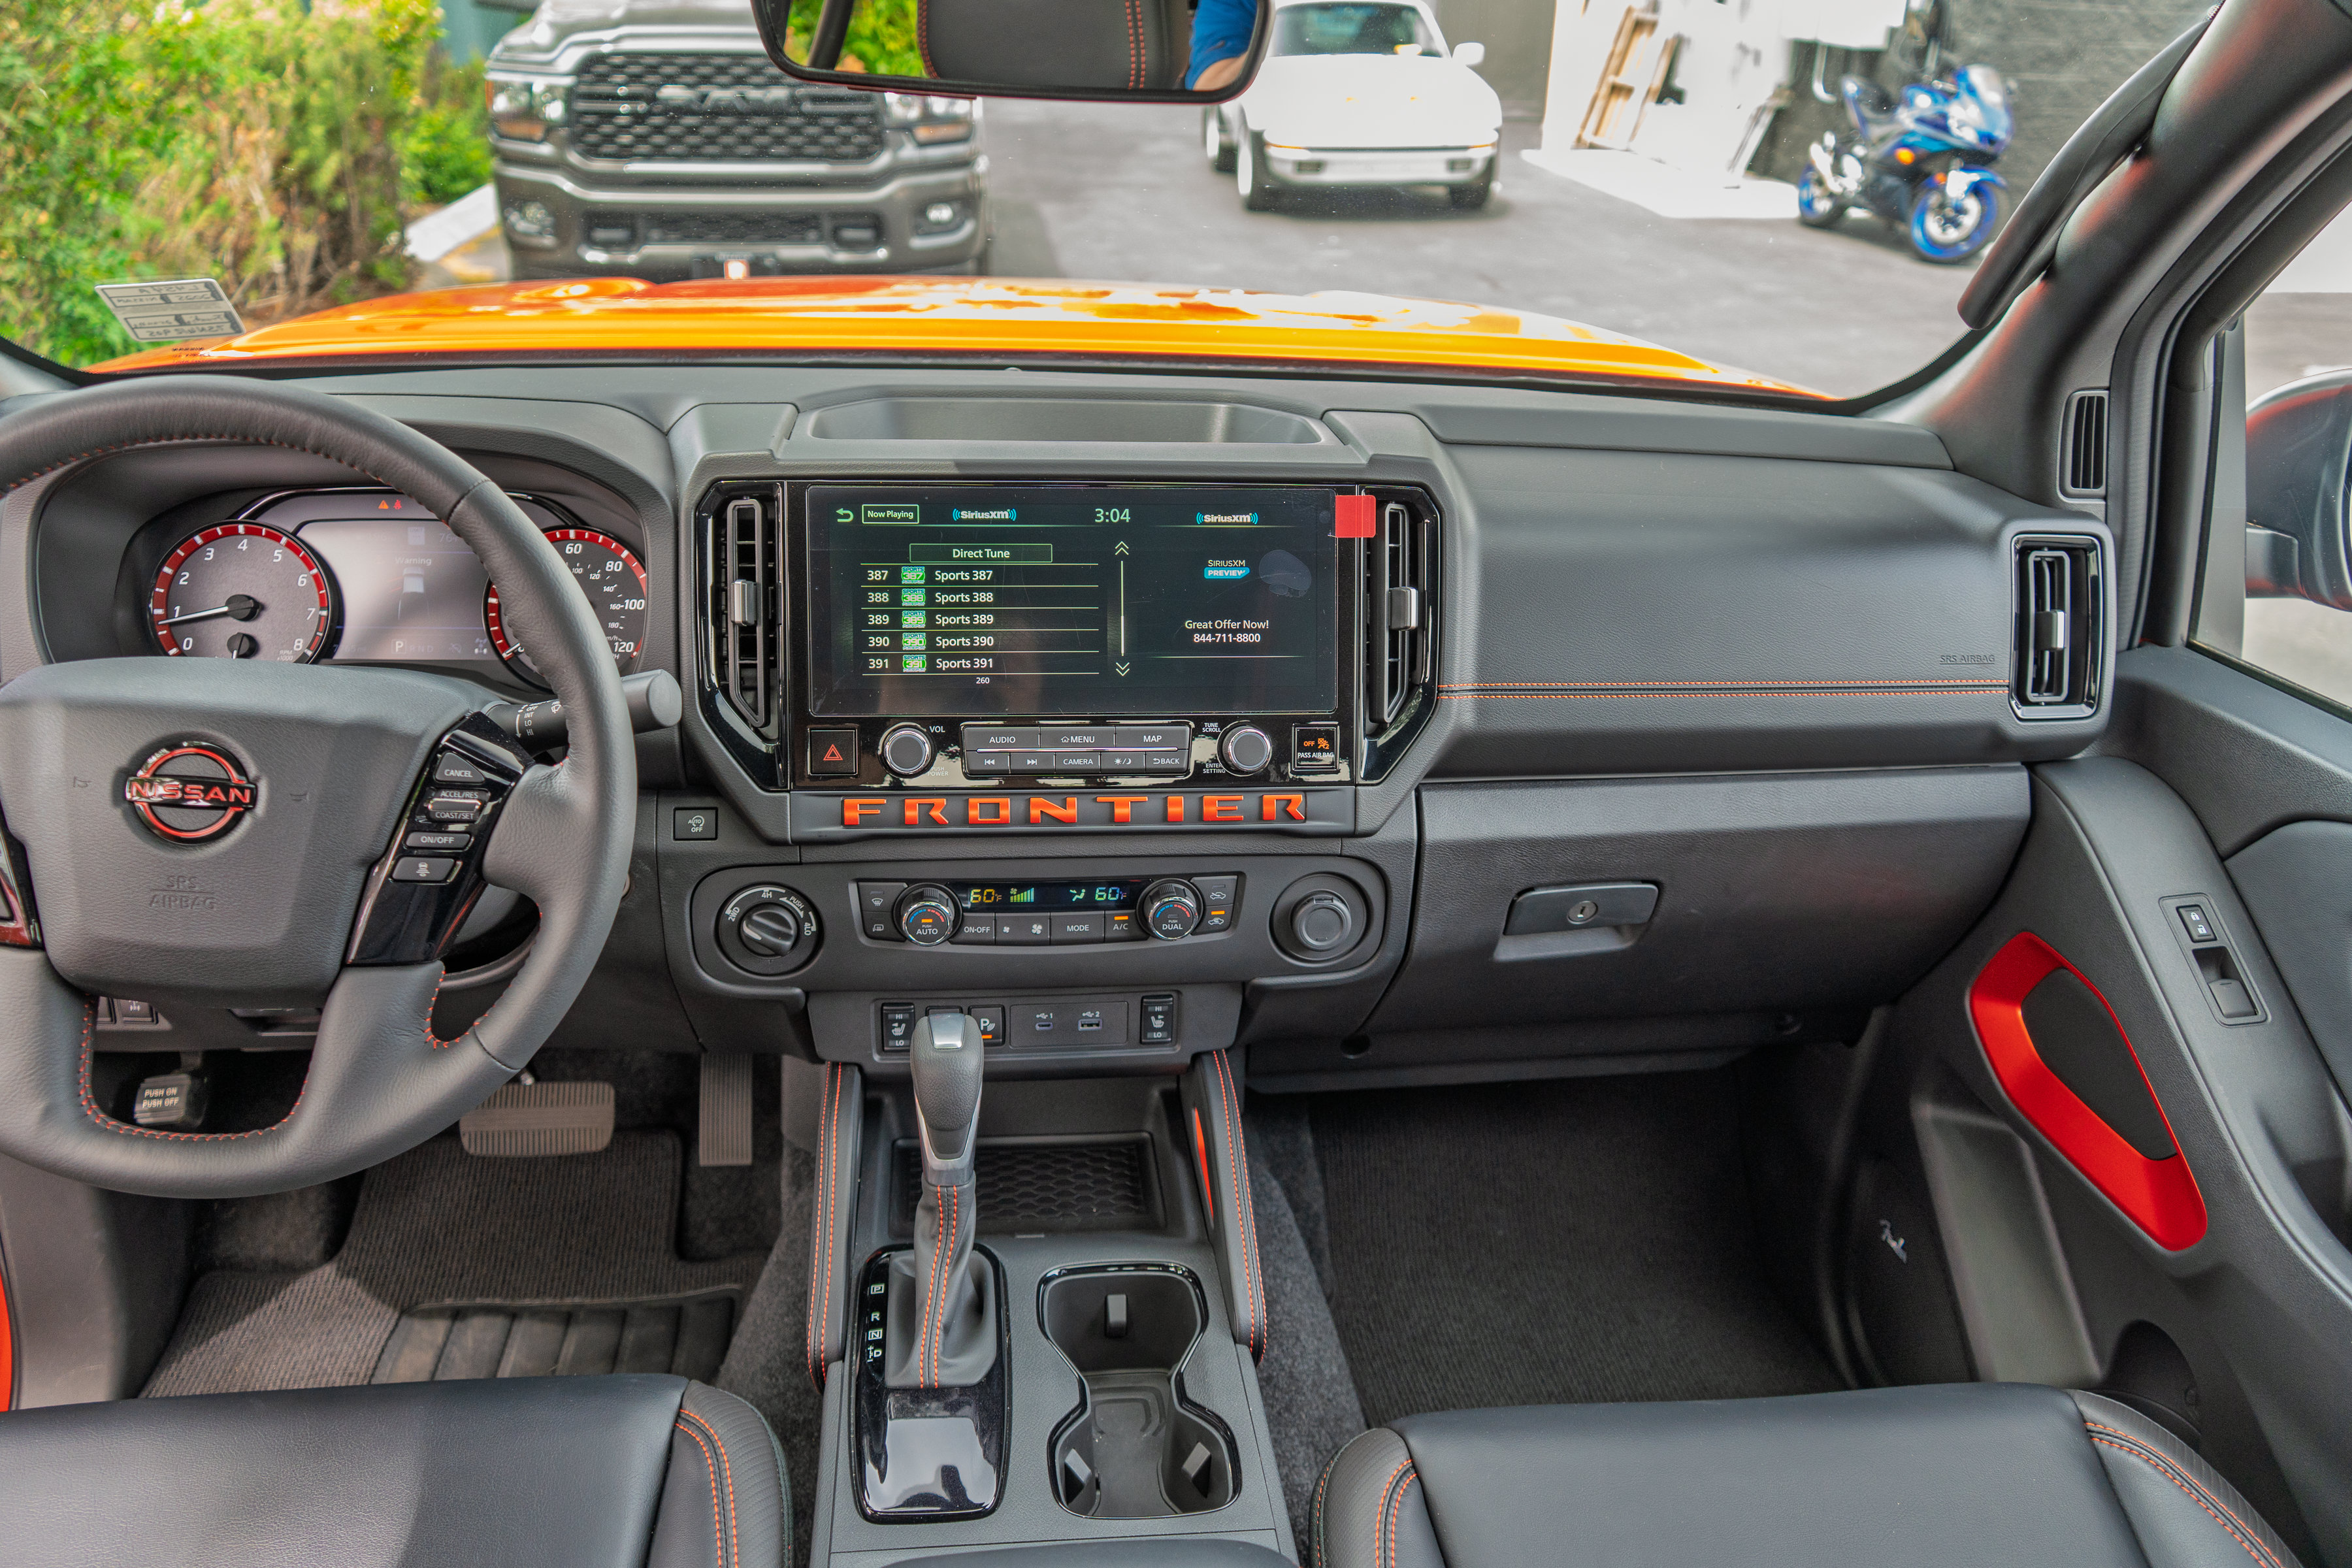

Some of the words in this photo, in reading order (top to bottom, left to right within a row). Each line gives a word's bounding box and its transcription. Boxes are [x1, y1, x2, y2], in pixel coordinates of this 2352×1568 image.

[887, 510, 913, 519] Playing
[1094, 508, 1131, 523] 3:04
[237, 538, 248, 551] 4
[565, 543, 582, 554] 60
[204, 547, 214, 561] 3
[272, 549, 282, 563] 5
[952, 548, 983, 558] Direct
[985, 549, 1010, 558] Tune
[395, 557, 433, 566] Warning
[605, 561, 623, 572] 80
[178, 572, 189, 585] 2
[297, 574, 307, 587] 6
[867, 570, 889, 581] 387
[935, 570, 971, 583] Sports
[972, 570, 993, 581] 387
[868, 592, 889, 602] 388
[935, 592, 971, 605] Sports
[972, 592, 993, 602] 388
[624, 598, 645, 610] 100
[174, 606, 180, 618] 1
[306, 608, 316, 621] 7
[868, 614, 890, 625] 389
[936, 614, 971, 627] Sports
[972, 614, 994, 625] 389
[1185, 620, 1213, 630] Great
[1215, 620, 1241, 630] Offer
[1243, 620, 1269, 630] Now!
[183, 638, 193, 649] 0
[293, 638, 304, 651] 8
[868, 636, 890, 647] 390
[936, 636, 972, 649] Sports
[973, 636, 994, 647] 390
[1193, 634, 1261, 643] 844-711-8800
[395, 641, 404, 652] P
[613, 642, 634, 653] 120
[868, 659, 889, 669] 391
[936, 658, 972, 670] Sports
[973, 659, 993, 669] 391
[1939, 655, 1957, 663] SRS
[1960, 655, 1995, 663] AIRBAG
[444, 769, 473, 778] CANCEL
[130, 781, 252, 804] NISSAN
[842, 794, 1306, 825] FRONTIER
[789, 895, 805, 909] PUSH
[728, 906, 740, 922] 2WD
[804, 922, 812, 936] 4LO
[144, 1088, 164, 1098] PUSH
[165, 1087, 178, 1096] ON
[142, 1099, 163, 1109] PUSH
[165, 1097, 179, 1107] OFF
[872, 1311, 880, 1321] R
[874, 1349, 882, 1358] D
